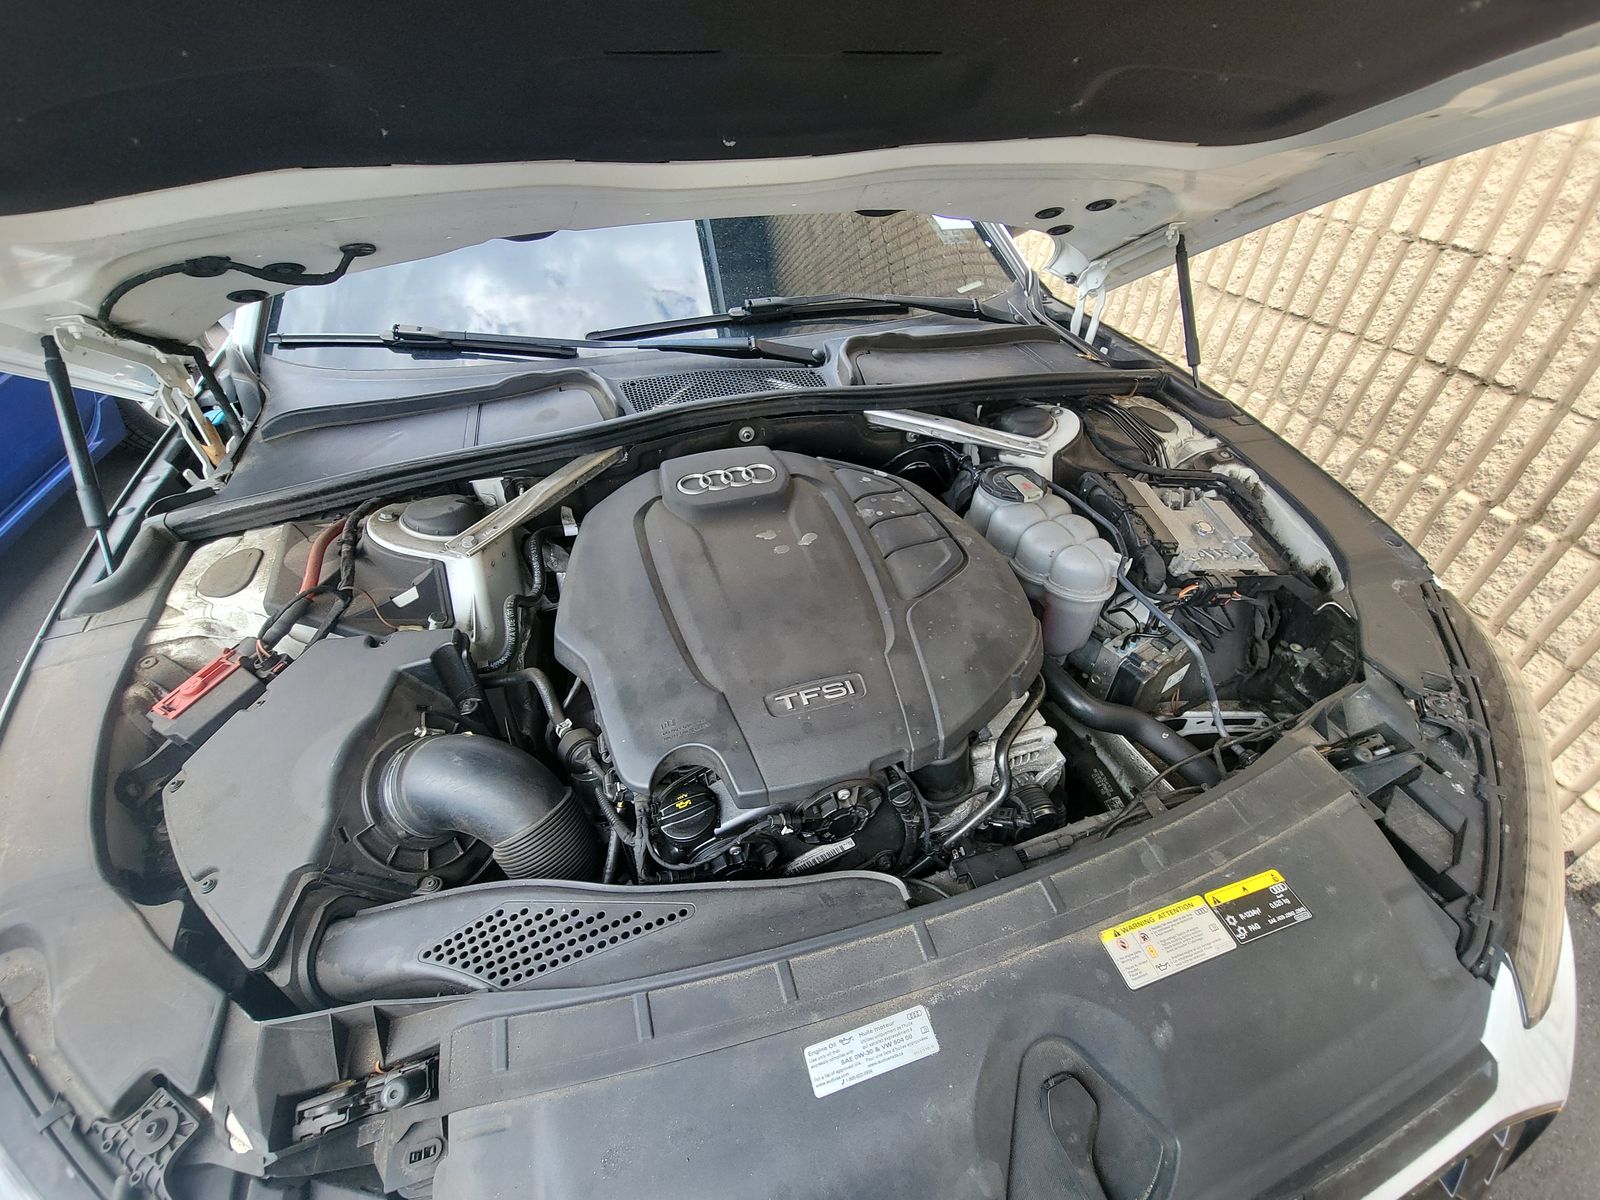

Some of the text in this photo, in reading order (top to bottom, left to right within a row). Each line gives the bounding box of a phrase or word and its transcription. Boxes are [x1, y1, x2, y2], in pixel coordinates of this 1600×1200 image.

[775, 680, 855, 710] TFSI
[1120, 917, 1156, 934] WARNING
[1157, 902, 1195, 920] ATTENTION
[858, 1021, 894, 1037] Huile moteur
[808, 1047, 827, 1057] Engine
[841, 1056, 853, 1065] SAE
[854, 1049, 873, 1060] 0W-30
[881, 1041, 892, 1049] VW
